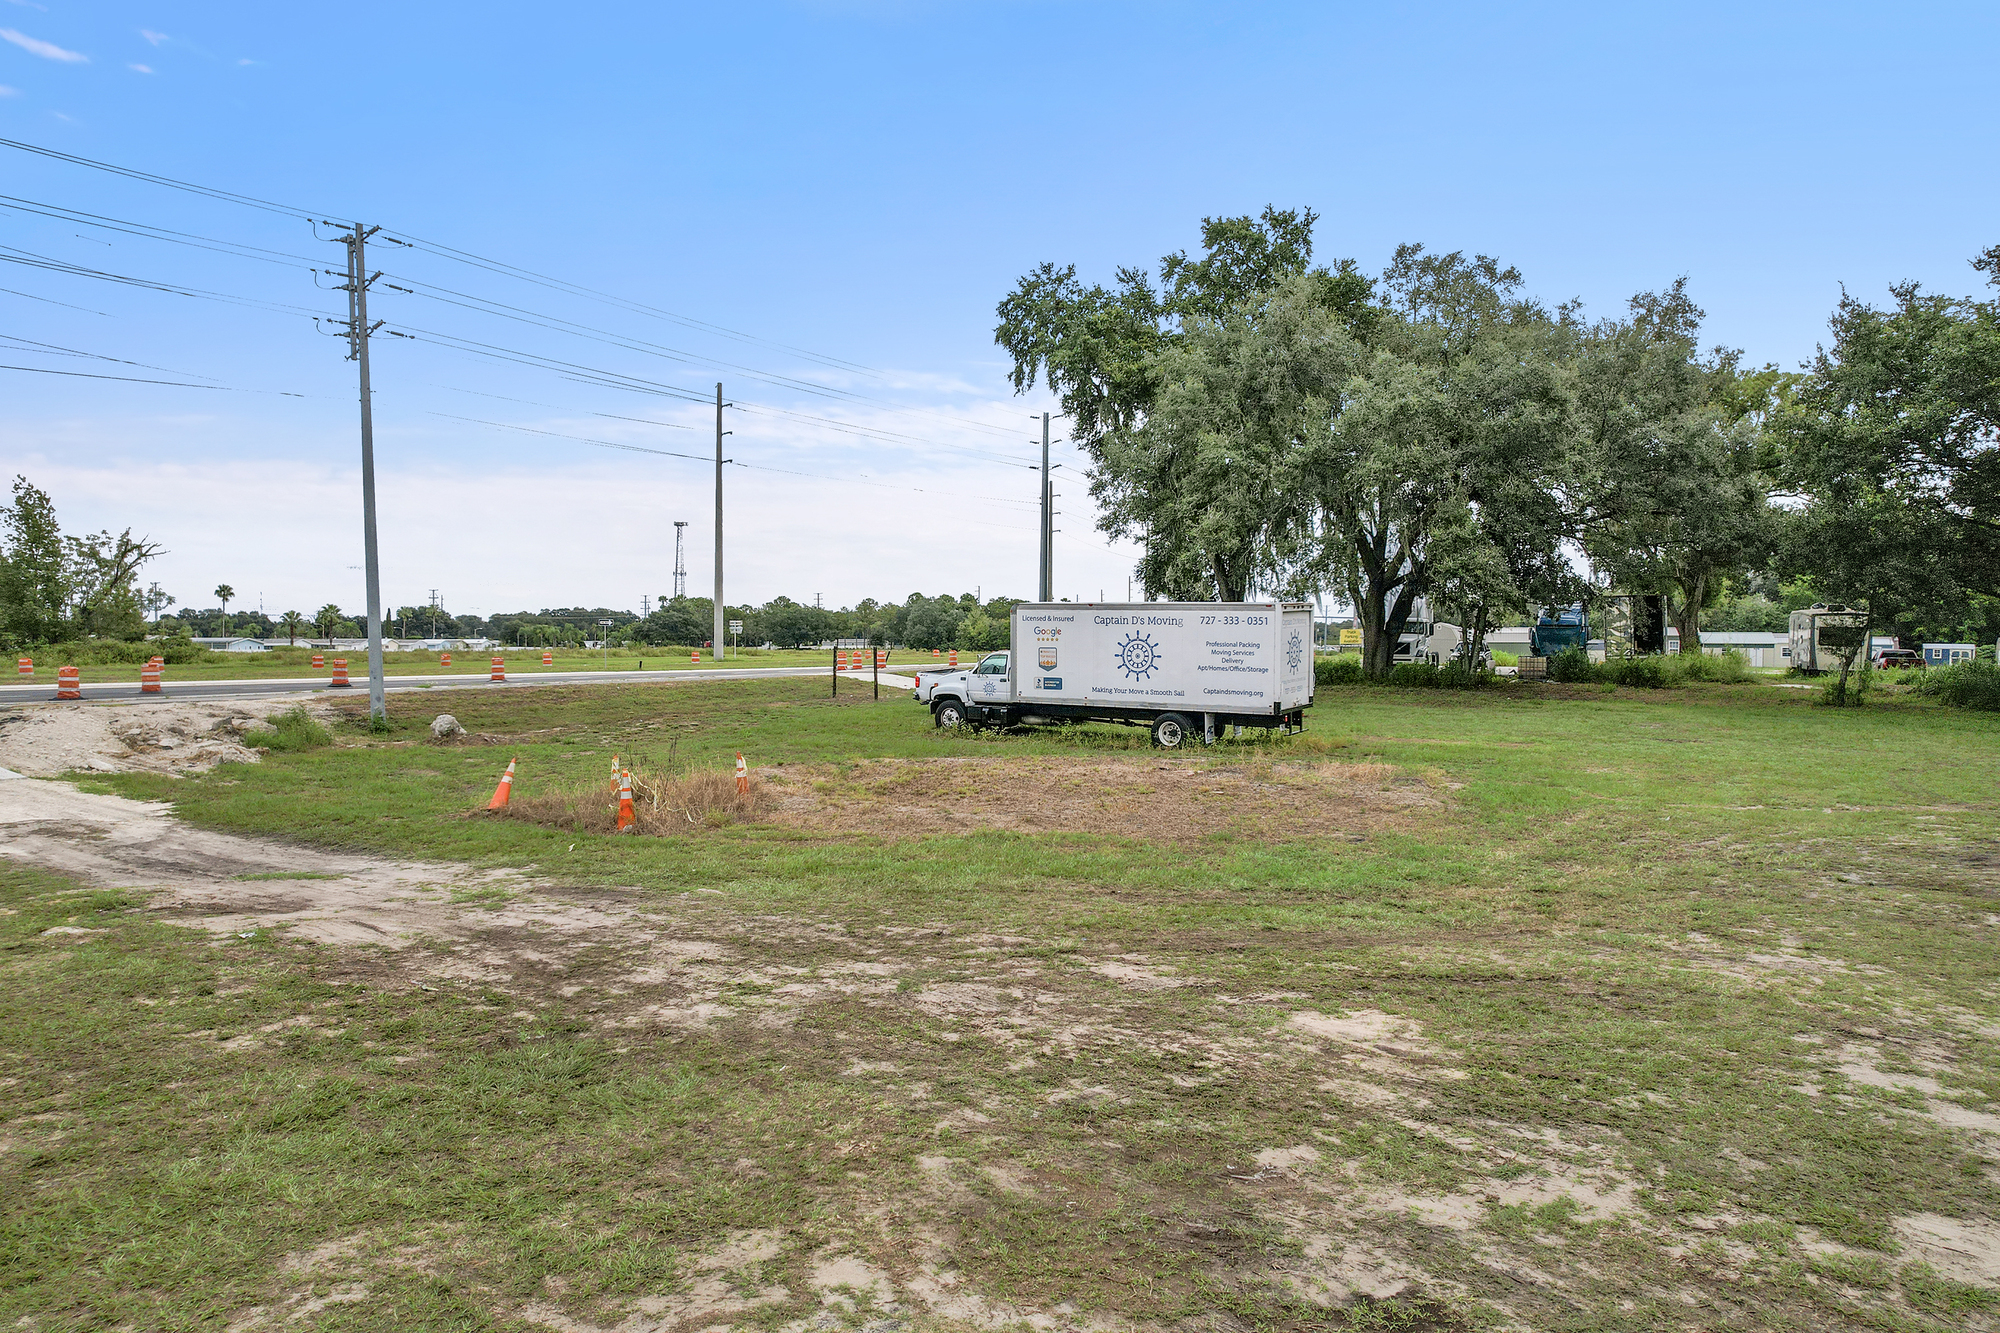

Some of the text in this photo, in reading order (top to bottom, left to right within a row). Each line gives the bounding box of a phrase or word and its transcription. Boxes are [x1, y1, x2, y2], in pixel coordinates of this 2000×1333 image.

[1094, 616, 1183, 627] Captain D's Moving
[1200, 616, 1216, 625] 727
[1224, 616, 1239, 625] 333
[1247, 617, 1268, 625] 0351
[1034, 626, 1062, 637] Google
[1203, 688, 1264, 697] Captaindsmoving.org
